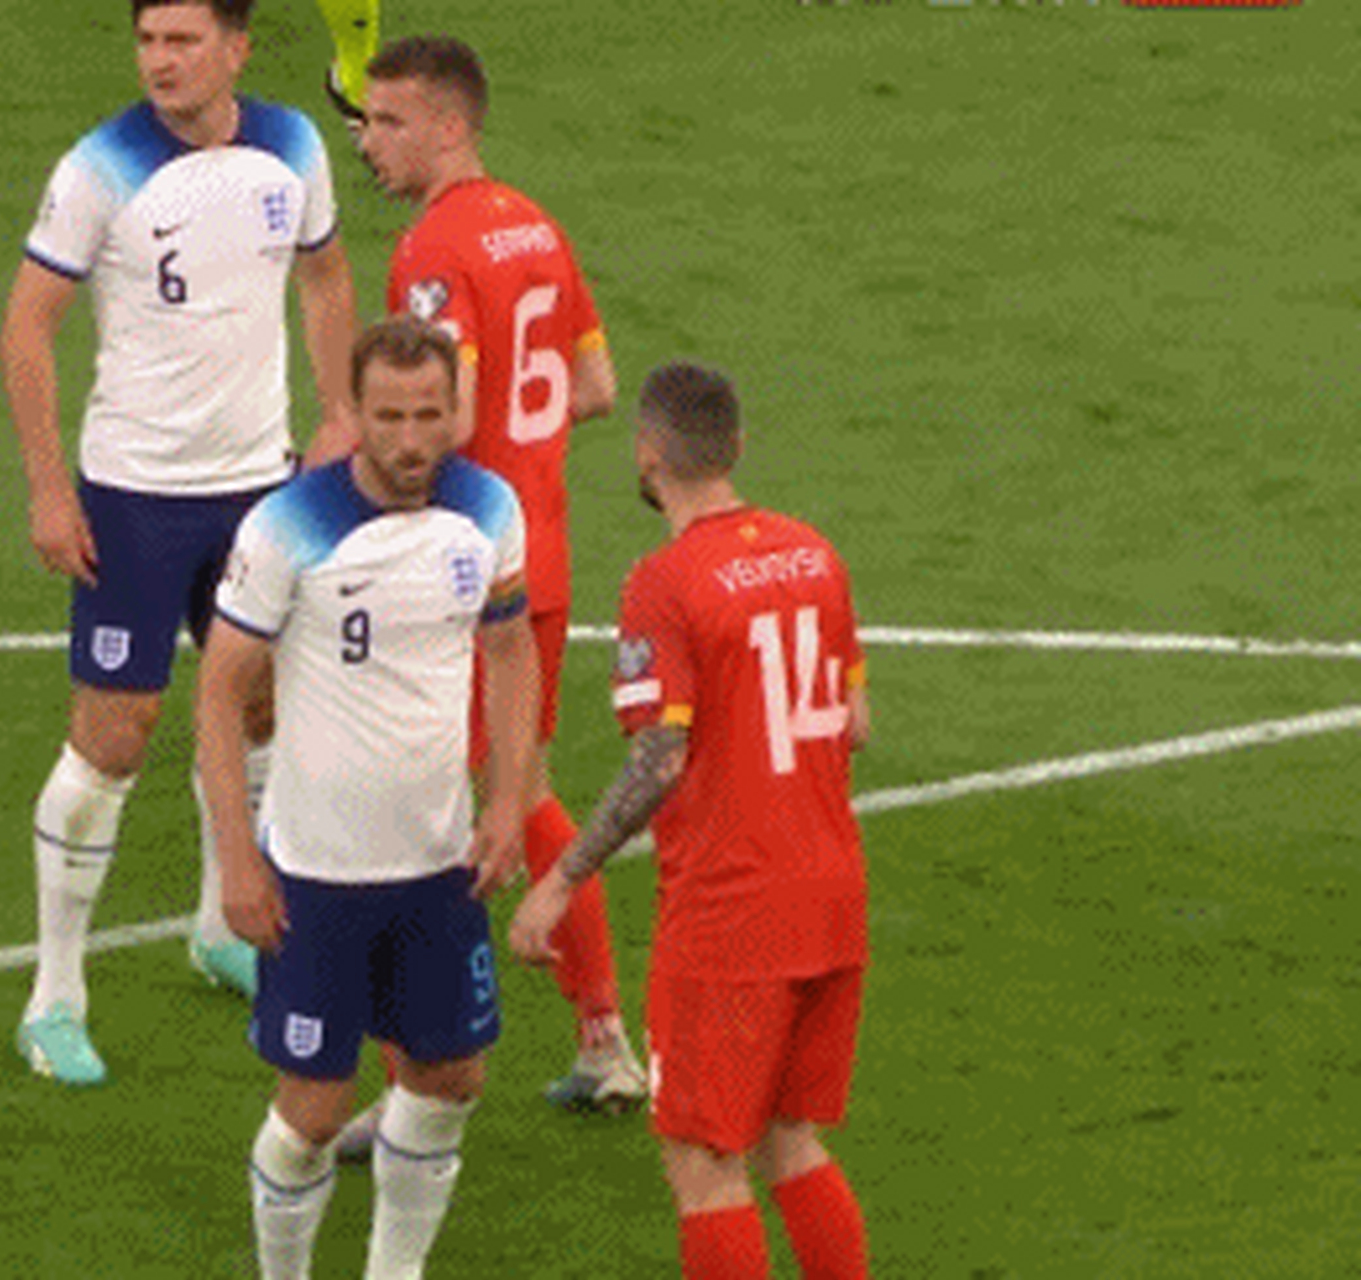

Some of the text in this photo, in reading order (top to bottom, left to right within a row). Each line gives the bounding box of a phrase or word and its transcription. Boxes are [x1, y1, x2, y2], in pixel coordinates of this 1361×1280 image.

[158, 249, 188, 305] 6
[507, 283, 570, 445] 6
[340, 607, 372, 665] 9
[748, 605, 850, 775] 14
